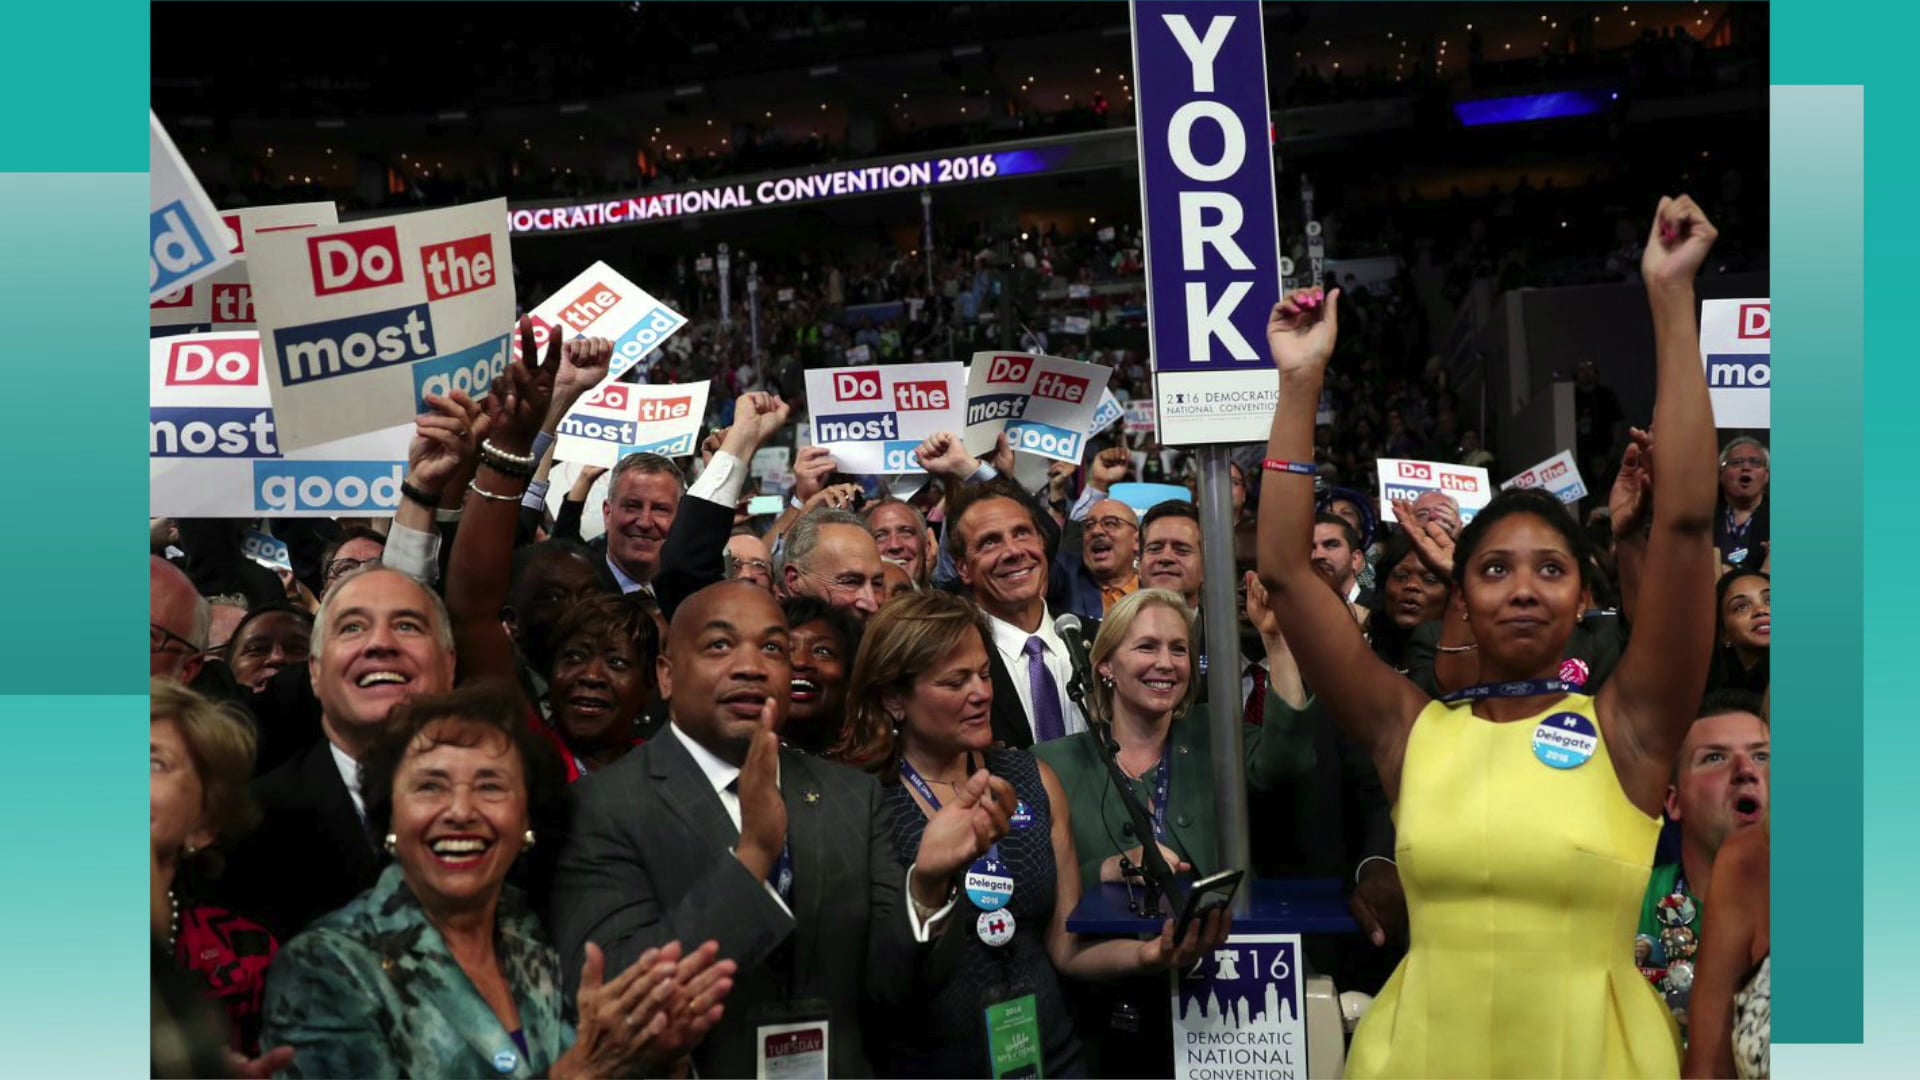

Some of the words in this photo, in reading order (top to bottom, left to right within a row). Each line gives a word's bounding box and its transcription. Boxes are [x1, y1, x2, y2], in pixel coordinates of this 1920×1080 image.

[628, 186, 752, 219] NATIONAL
[757, 162, 931, 204] CONVENTION
[937, 154, 997, 182] 2016
[1161, 14, 1260, 361] YORK
[317, 238, 394, 290] Do
[427, 245, 492, 296] the
[565, 291, 616, 327] the
[284, 309, 431, 382] most
[175, 344, 251, 382] Do
[837, 375, 878, 399] Do
[897, 384, 946, 409] the
[991, 358, 1026, 381] Do
[1038, 374, 1084, 401] the
[642, 401, 687, 420] the
[967, 396, 1024, 425] most
[1167, 405, 1214, 415] NATIONAL
[556, 419, 633, 443] most
[820, 414, 895, 441] most
[1006, 425, 1078, 457] good
[1400, 464, 1430, 479] Do
[1441, 474, 1476, 491] the
[1516, 474, 1535, 488] Do
[1542, 464, 1566, 482] the
[261, 464, 403, 513] good
[1536, 728, 1591, 749] Delegate
[969, 877, 1013, 890] Delegate
[768, 1040, 820, 1056] TUESDAY
[1187, 1032, 1292, 1045] DEMOCRATIC
[1188, 1049, 1293, 1065] NATIONAL
[1189, 1068, 1294, 1080] CONVENTION
